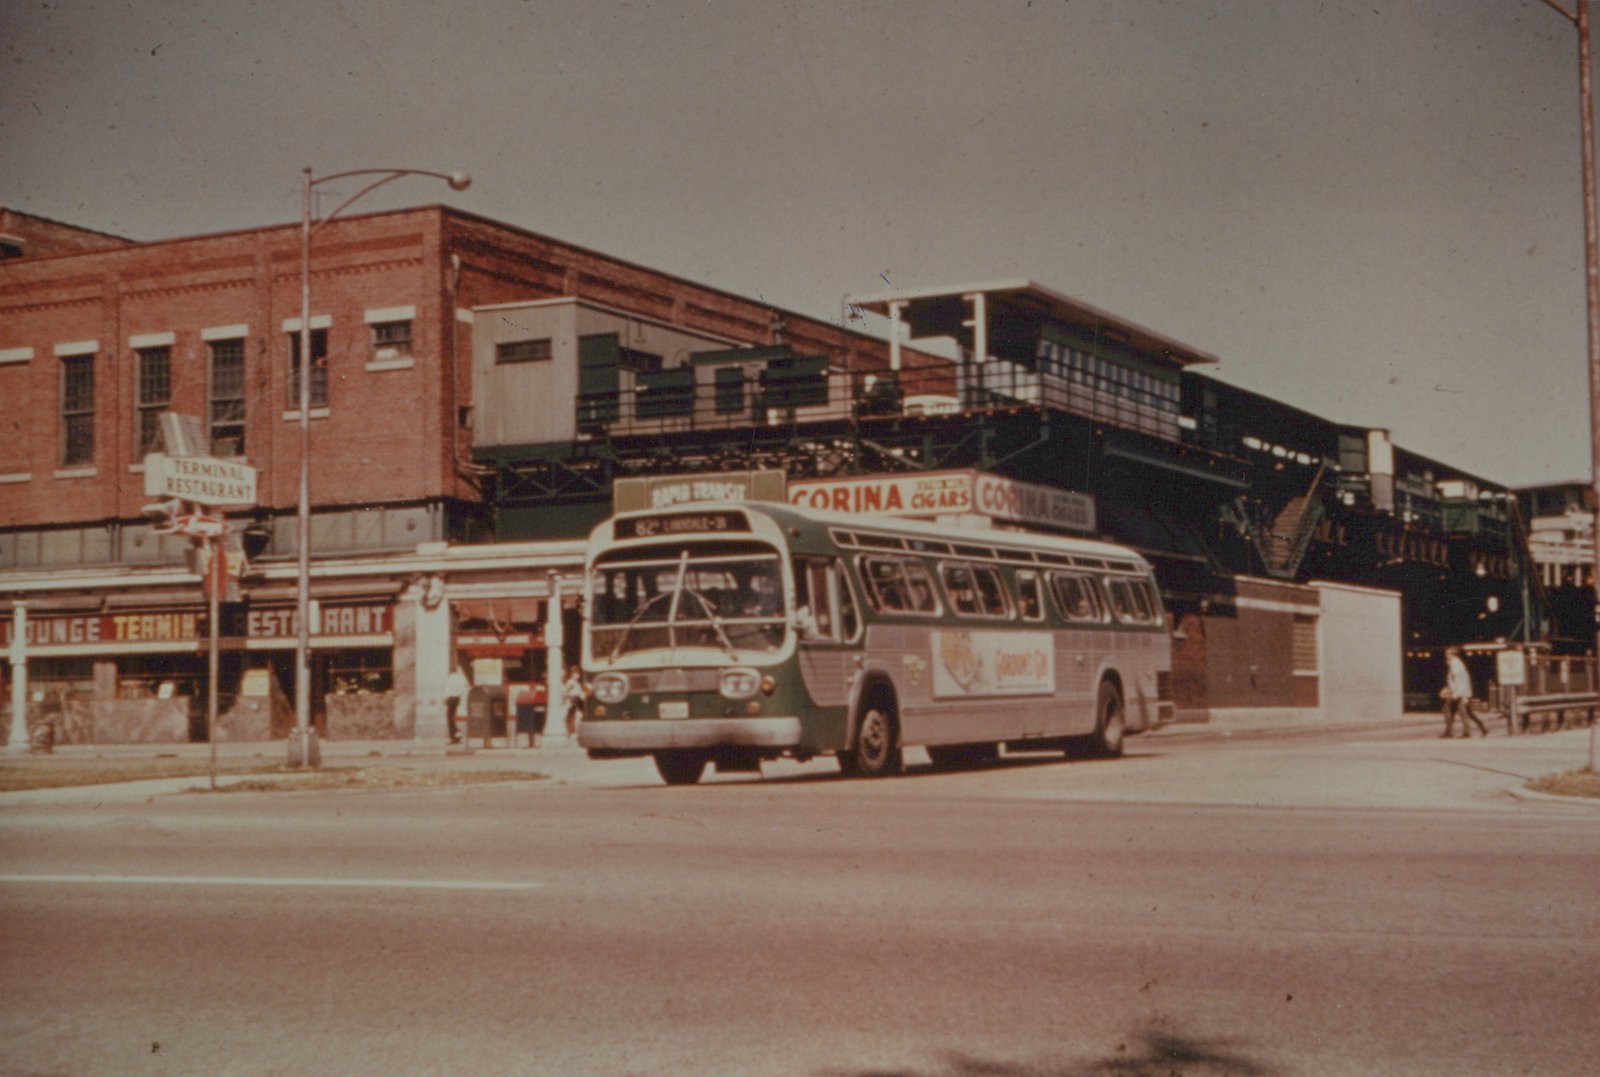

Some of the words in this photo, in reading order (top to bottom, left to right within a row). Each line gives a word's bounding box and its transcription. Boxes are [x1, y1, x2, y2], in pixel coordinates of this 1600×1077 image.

[174, 460, 245, 481] TERMINAL
[166, 476, 252, 500] RESTAURANT
[791, 484, 904, 513] CORINA
[911, 490, 970, 509] CIGARS
[113, 613, 207, 641] TERMIN
